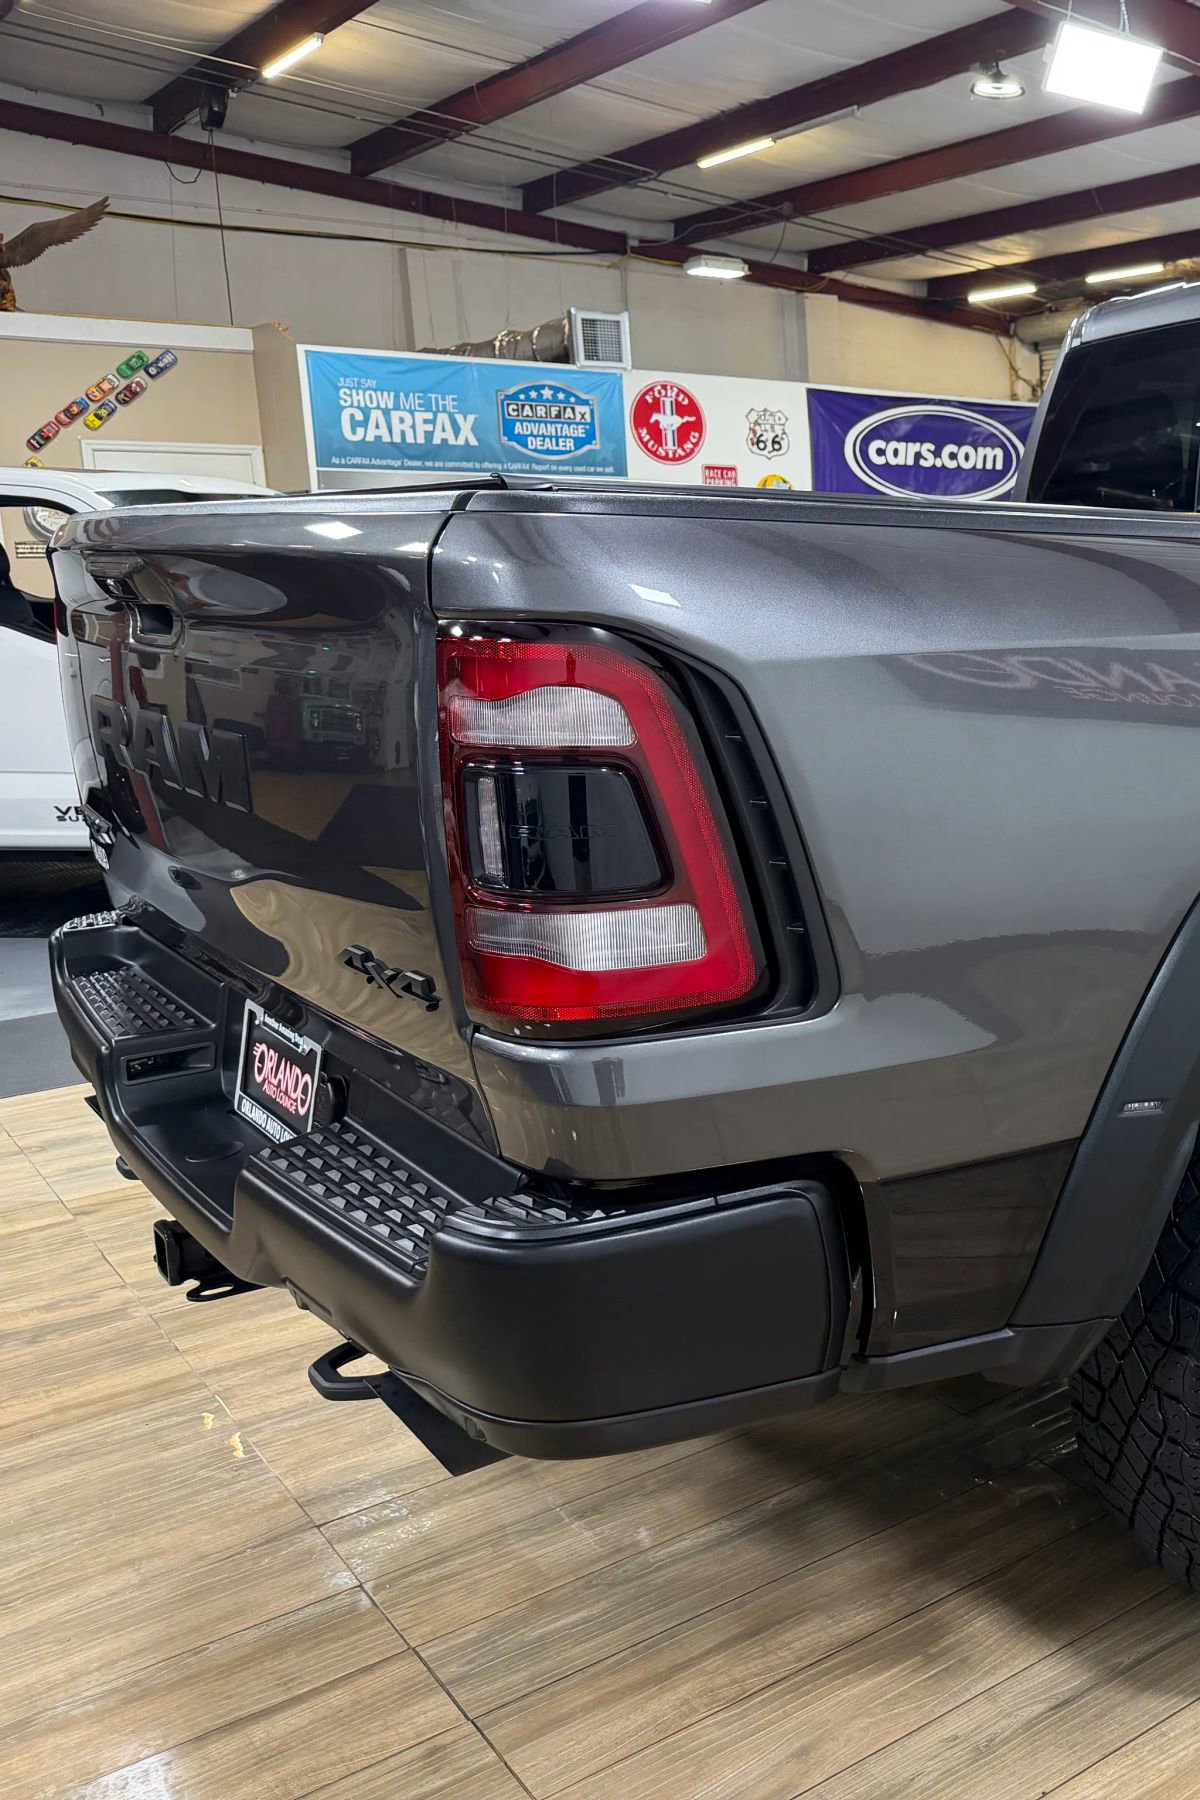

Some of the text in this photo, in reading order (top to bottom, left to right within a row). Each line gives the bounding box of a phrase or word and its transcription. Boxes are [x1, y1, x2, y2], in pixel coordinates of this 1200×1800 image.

[337, 377, 377, 389] JUST SAY
[645, 385, 689, 405] FORD
[339, 388, 459, 413] SHOW ME THE
[506, 403, 589, 422] CARFAX
[341, 407, 479, 446] CARFAX
[514, 422, 586, 437] ADVANTAGE
[527, 437, 575, 451] DEALER
[639, 427, 700, 458] MUSTANG
[868, 439, 1004, 471] cars.com
[90, 694, 253, 814] RAM
[509, 824, 621, 840] RAM
[253, 1042, 312, 1116] ORLANDO
[262, 1078, 297, 1115] AUTO LOUNGE
[241, 1098, 268, 1129] ORLANDO
[265, 1117, 281, 1140] AUTO
